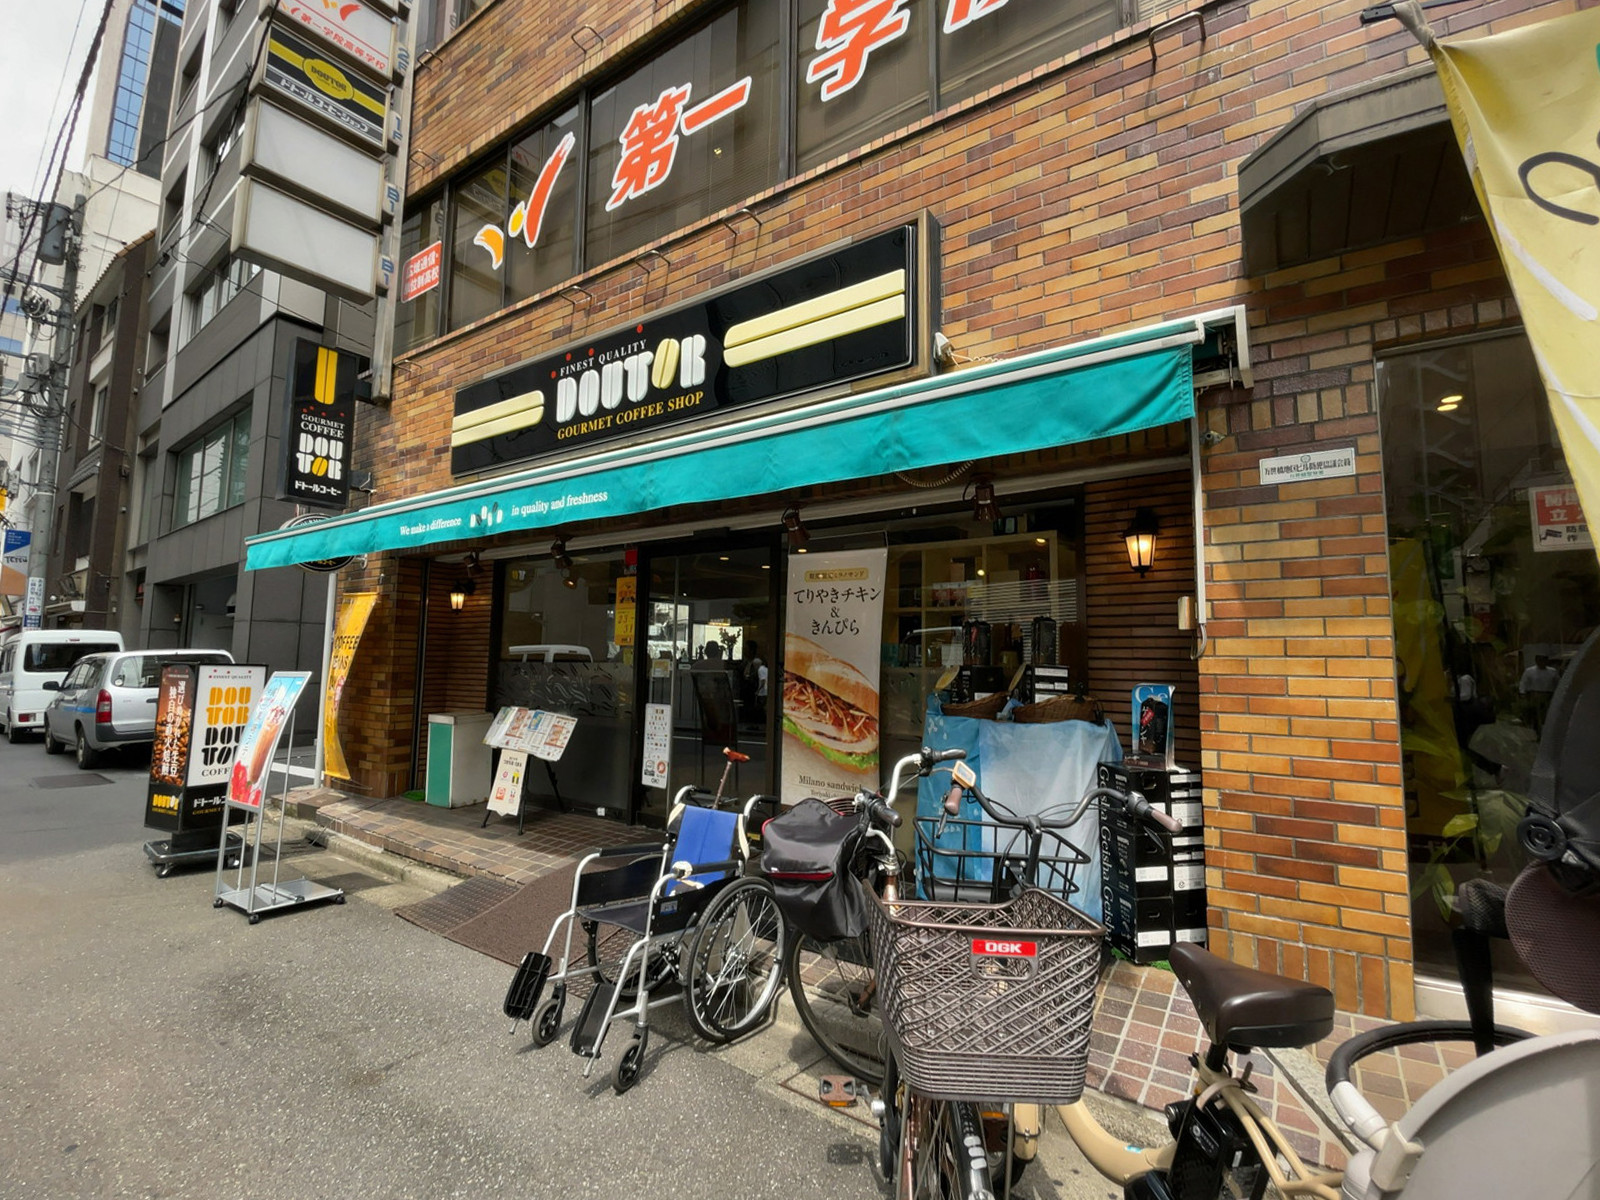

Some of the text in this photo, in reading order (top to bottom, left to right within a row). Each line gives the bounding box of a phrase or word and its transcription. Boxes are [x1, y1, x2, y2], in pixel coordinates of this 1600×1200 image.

[560, 338, 647, 377] FINEST QUALITY
[556, 333, 706, 424] DOUTOR
[301, 413, 345, 430] GOURMET
[557, 390, 704, 440] GOURMET COFFEE SHOP
[300, 421, 345, 439] COFFEE
[299, 432, 344, 460] DOU
[296, 452, 343, 480] TOR
[295, 480, 342, 496] ドトールコーヒー
[400, 526, 410, 536] We
[410, 523, 426, 535] make
[429, 516, 462, 531] difference
[511, 505, 520, 516] in
[520, 501, 549, 517] quality
[550, 496, 566, 510] and
[566, 491, 608, 507] freshness
[793, 586, 882, 604] てりやきチキン
[830, 606, 841, 619] &
[811, 618, 860, 636] きんぴら
[334, 635, 360, 650] COFFEE
[209, 686, 252, 706] DOU
[206, 705, 250, 726] TOR
[799, 774, 826, 788] Milano
[1100, 825, 1113, 881] Geisha
[1103, 885, 1115, 942] Geisha
[985, 942, 1022, 953] OGK
